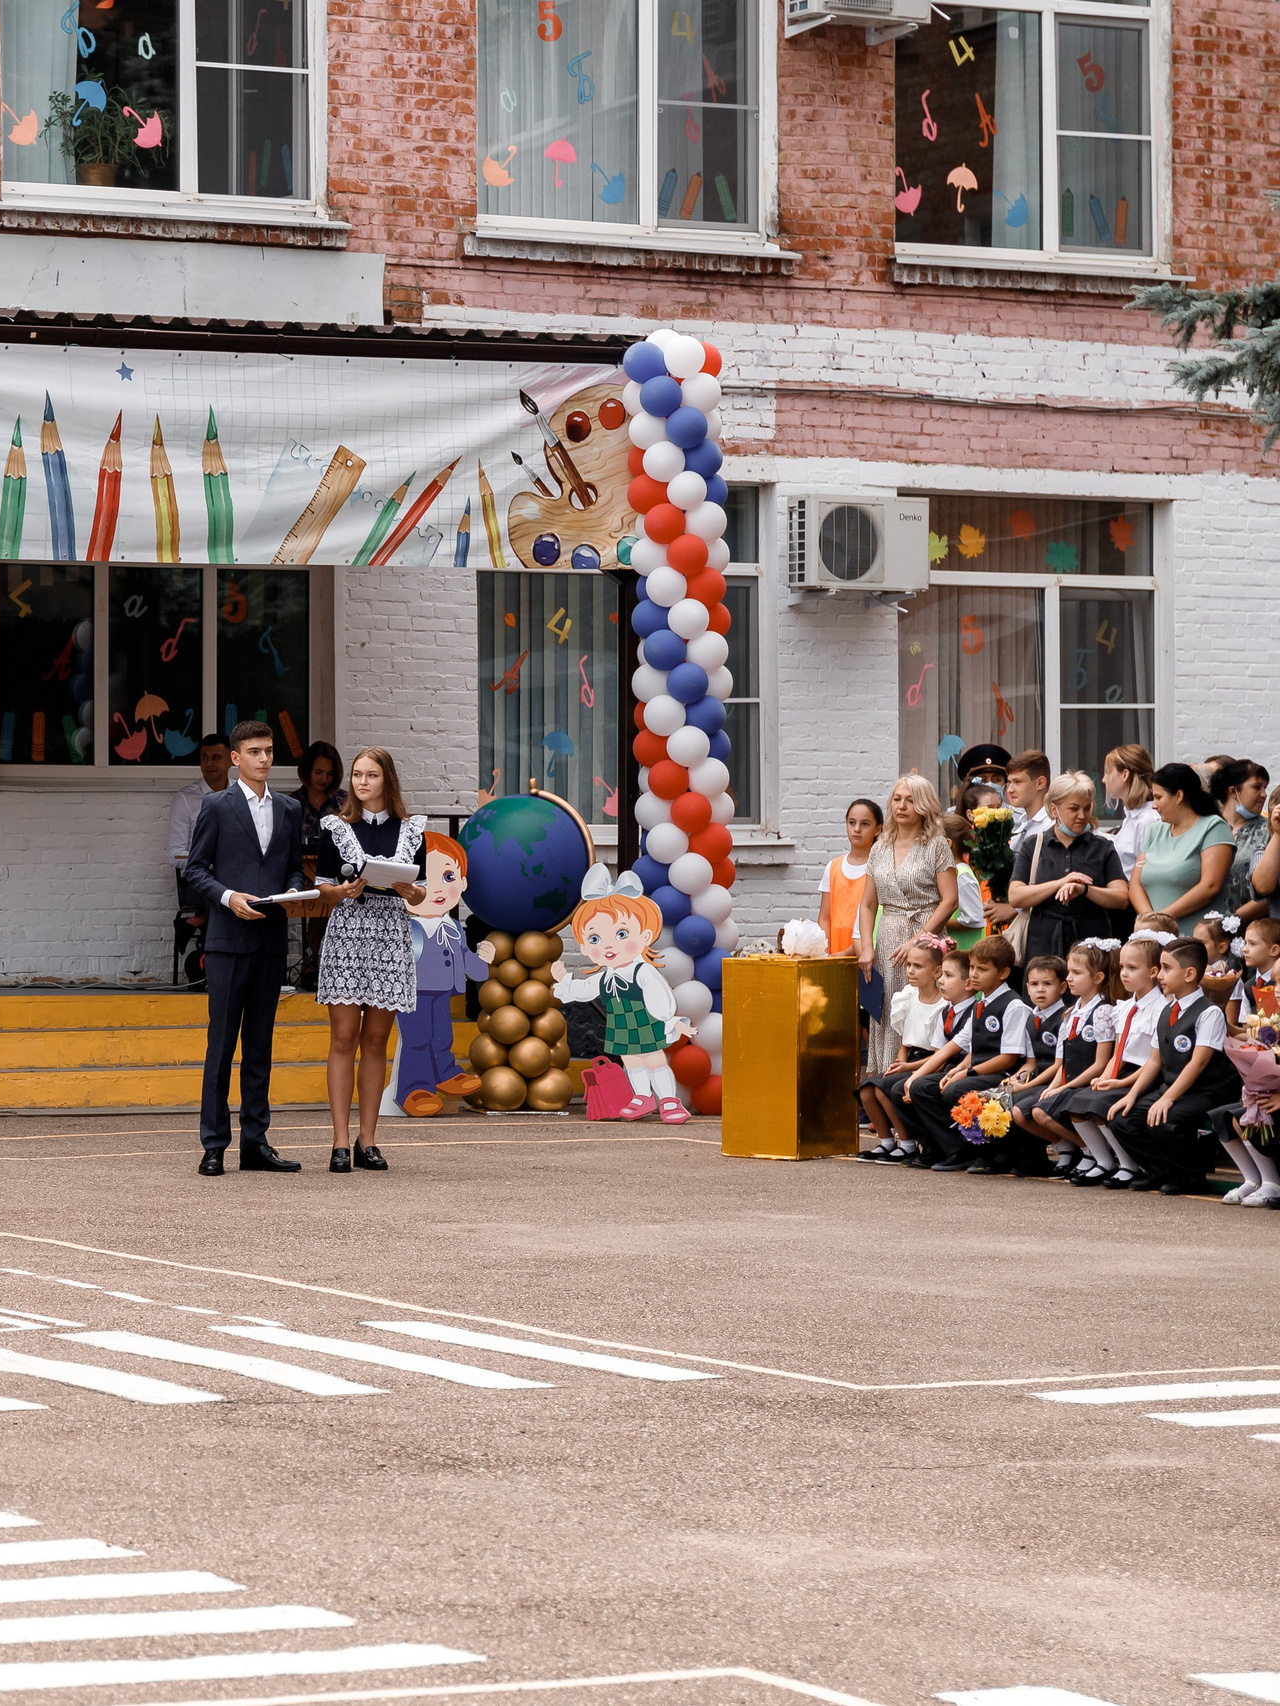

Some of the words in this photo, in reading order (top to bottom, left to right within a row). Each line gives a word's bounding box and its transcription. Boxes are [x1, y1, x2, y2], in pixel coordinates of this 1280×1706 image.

[537, 1, 563, 42] 5
[671, 10, 695, 44] 4
[1076, 50, 1106, 93] 5
[899, 512, 923, 521] Denko
[546, 606, 572, 645] 4
[960, 614, 984, 656] 5
[1095, 619, 1118, 655] 4
